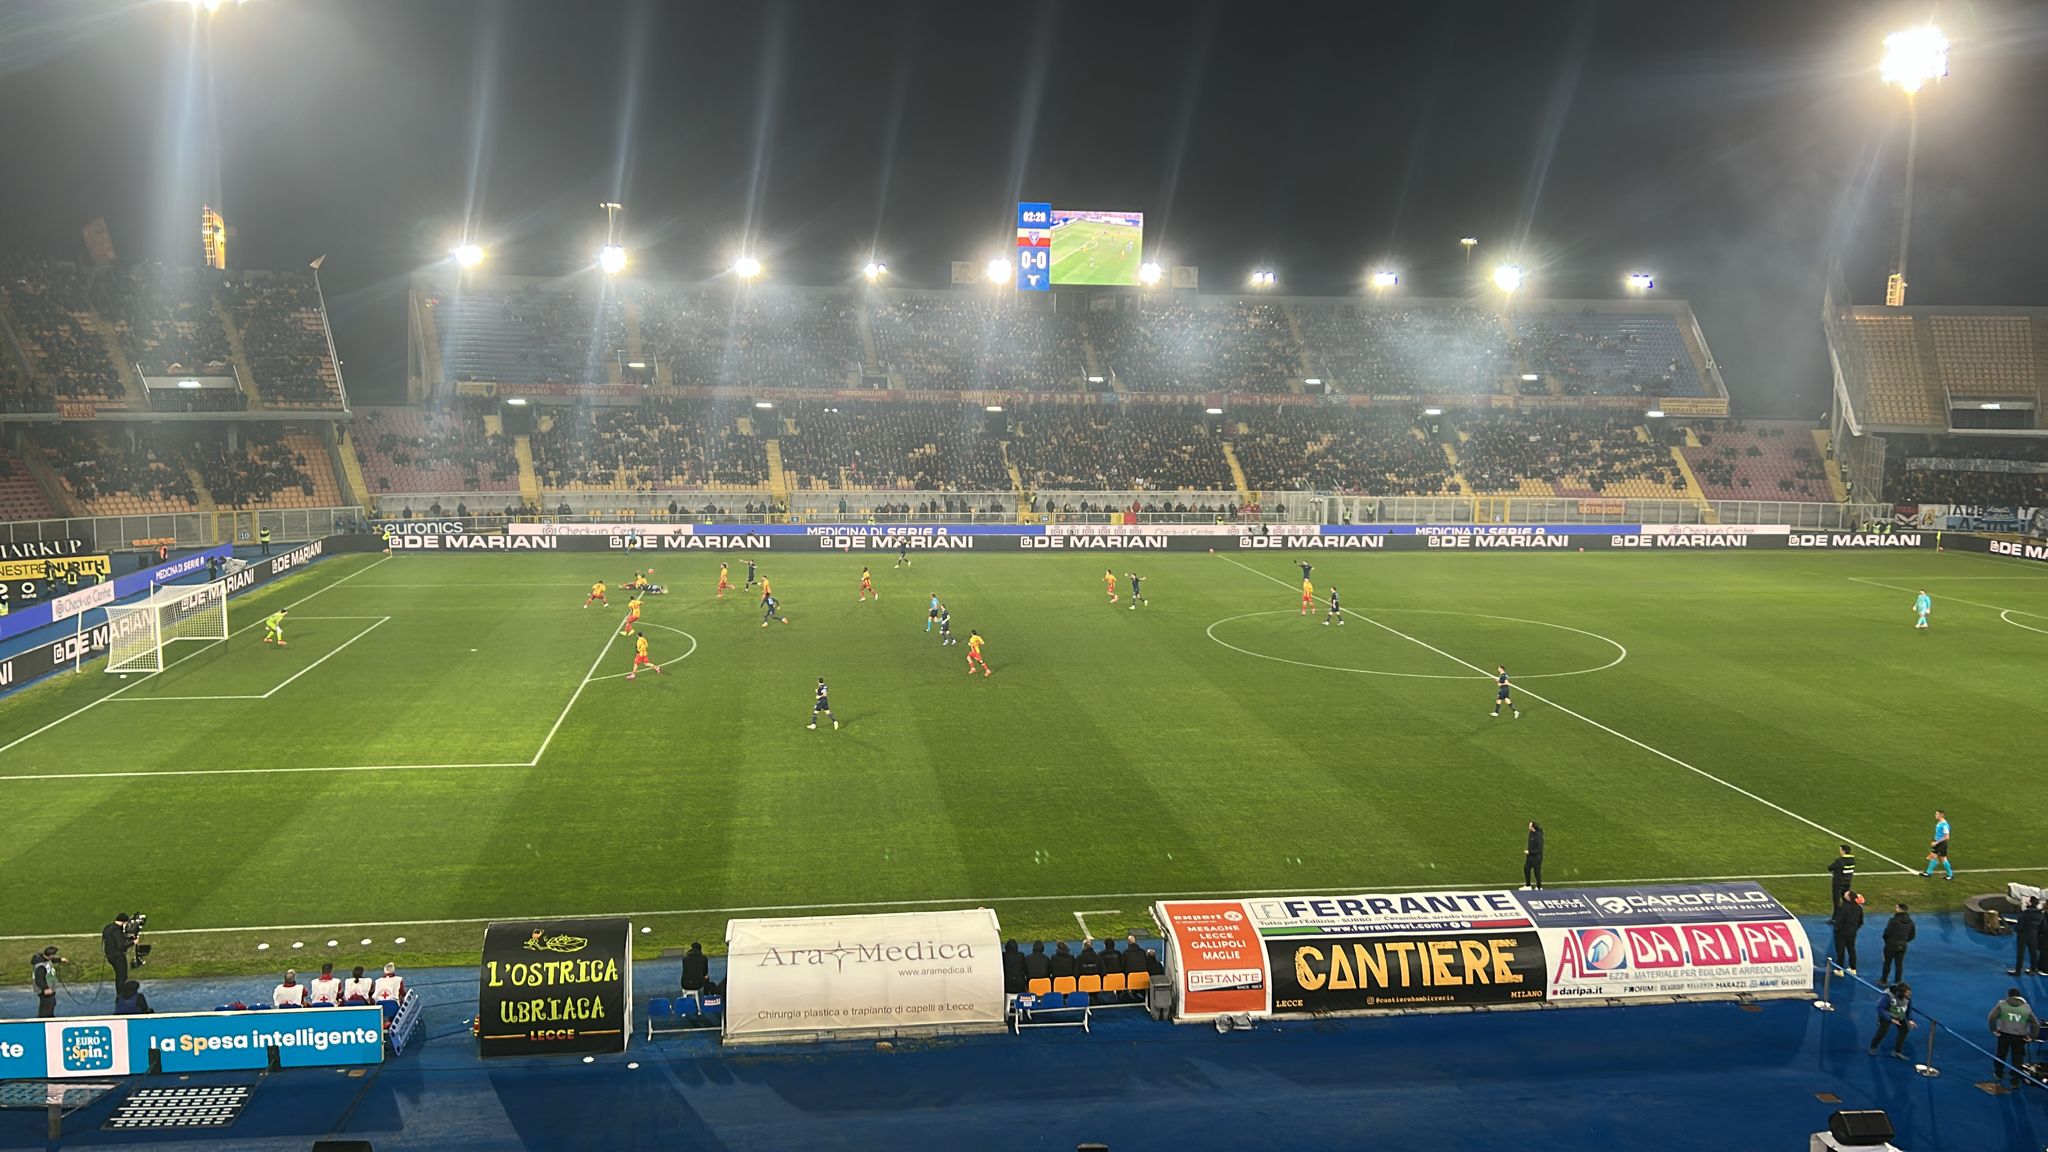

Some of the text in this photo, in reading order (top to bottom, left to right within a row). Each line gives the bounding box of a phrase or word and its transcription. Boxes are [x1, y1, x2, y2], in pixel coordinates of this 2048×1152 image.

[384, 522, 464, 534] euronics
[404, 536, 556, 548] DE MARIANI
[625, 536, 770, 548] DE MARIANI
[835, 536, 973, 548] DE MARIANI
[1034, 536, 1168, 548] DE MARIANI
[1253, 536, 1384, 547] DE MARIANI
[1441, 536, 1568, 547] DE MARIANI
[1624, 535, 1748, 546] DE MARIANI
[1800, 535, 1921, 546] DE MARIANI
[2000, 542, 2022, 556] DE
[278, 540, 322, 572] DE MARIANI
[66, 634, 90, 660] DE
[1284, 894, 1516, 918] FERRANTE
[1192, 940, 1246, 949] GALLIPOLI
[757, 940, 974, 967] Ara Medica
[1202, 951, 1240, 960] MAGLIE
[898, 966, 972, 976] www.aramedica.it
[1296, 939, 1524, 991] CANTIERE
[487, 957, 618, 987] L'OSTRICA
[1634, 970, 1678, 980] MATERIALE
[1680, 969, 1696, 977] PER
[1698, 968, 1730, 976] EDILIZIA
[1740, 966, 1773, 975] ARREDO
[1774, 965, 1802, 974] BAGNO
[1191, 973, 1260, 984] DISTANTE
[1560, 986, 1602, 996] daripa.it
[501, 995, 605, 1023] UBRIACA
[1276, 1000, 1304, 1008] LECCE
[758, 1008, 801, 1020] Chirurgia
[804, 1006, 840, 1018] plastica
[851, 1006, 892, 1017] trapianto
[894, 1004, 904, 1014] di
[906, 1004, 936, 1015] capelli
[946, 1002, 974, 1011] Lecce
[2008, 1012, 2022, 1022] TV
[530, 1029, 575, 1040] LECCE
[76, 1036, 100, 1046] EURO
[180, 1034, 248, 1056] Spesa
[252, 1028, 378, 1050] intelligente
[72, 1045, 103, 1061] Spin
